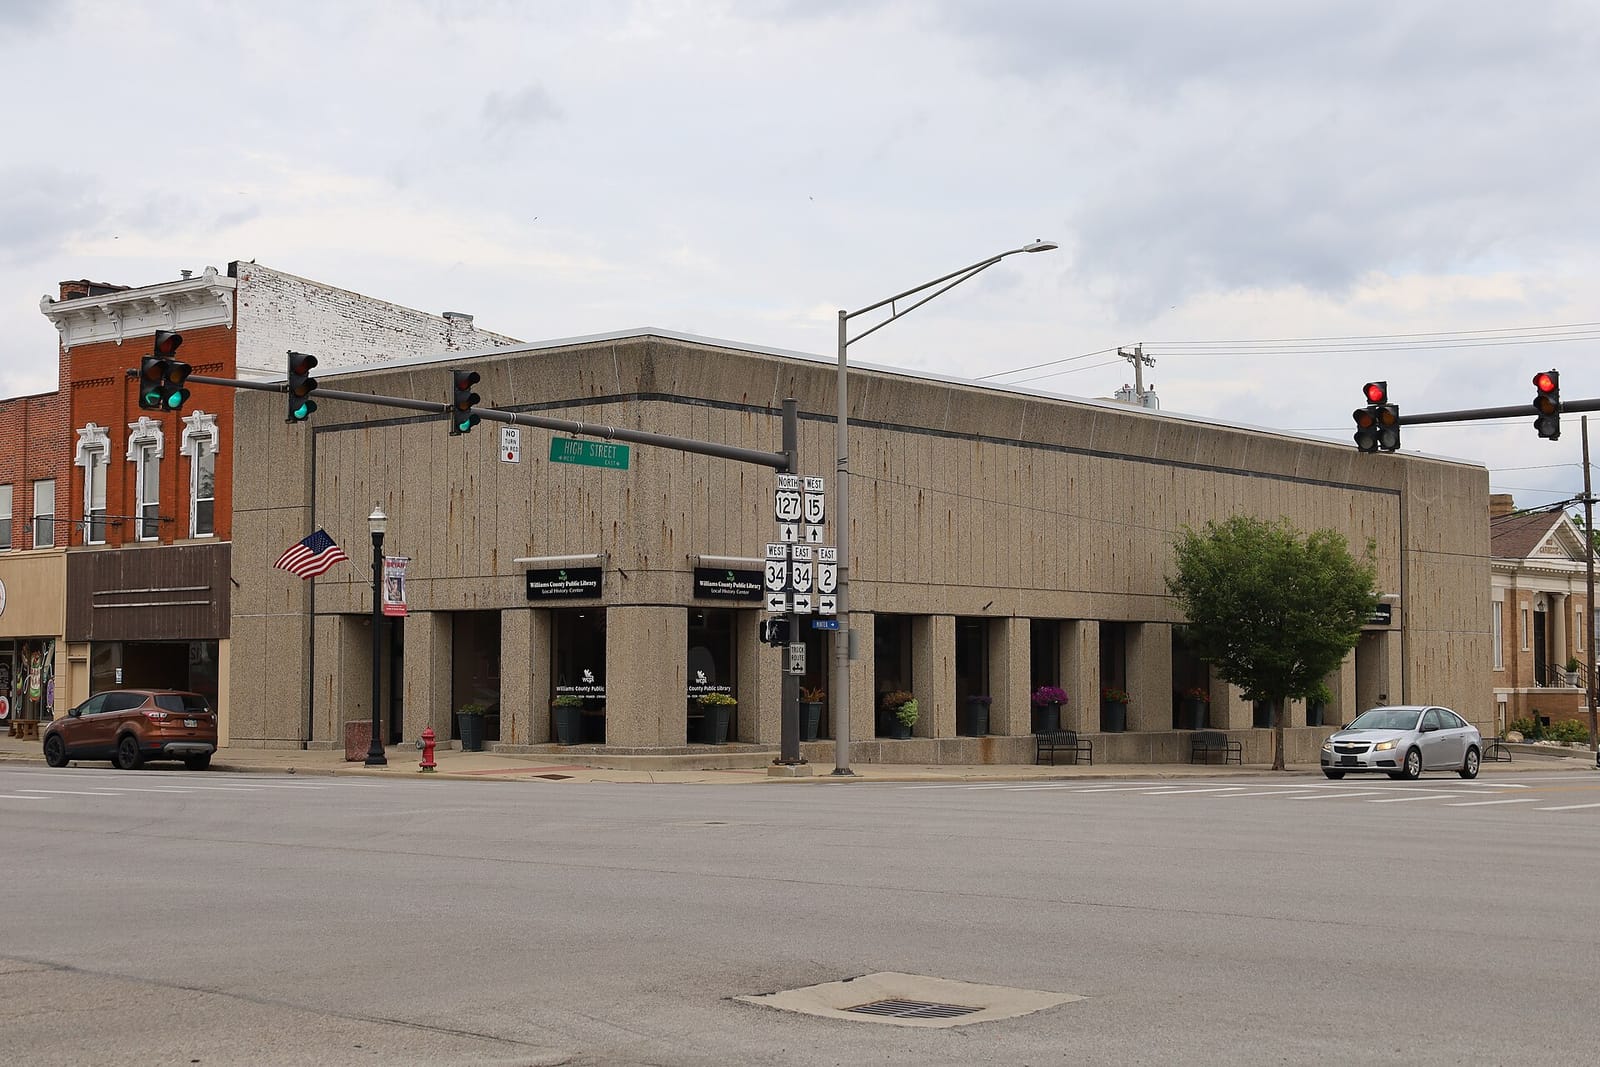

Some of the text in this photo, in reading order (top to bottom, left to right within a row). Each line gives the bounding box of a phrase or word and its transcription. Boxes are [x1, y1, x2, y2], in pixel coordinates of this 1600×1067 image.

[505, 430, 516, 438] NO
[504, 438, 517, 446] TURN
[564, 441, 617, 459] HIGH STREET
[778, 476, 798, 487] NORTH
[807, 478, 822, 489] WEST
[778, 497, 799, 515] 127
[809, 499, 820, 516] 15
[768, 545, 785, 556] WEST
[795, 548, 809, 558] EAST
[820, 549, 835, 559] EAST
[767, 566, 785, 584] 34
[794, 567, 810, 585] 34
[824, 569, 832, 586] 2
[718, 581, 732, 589] County
[746, 582, 761, 590] Library
[791, 654, 804, 662] ROUTE
[688, 685, 703, 693] County
[717, 685, 731, 693] Library
